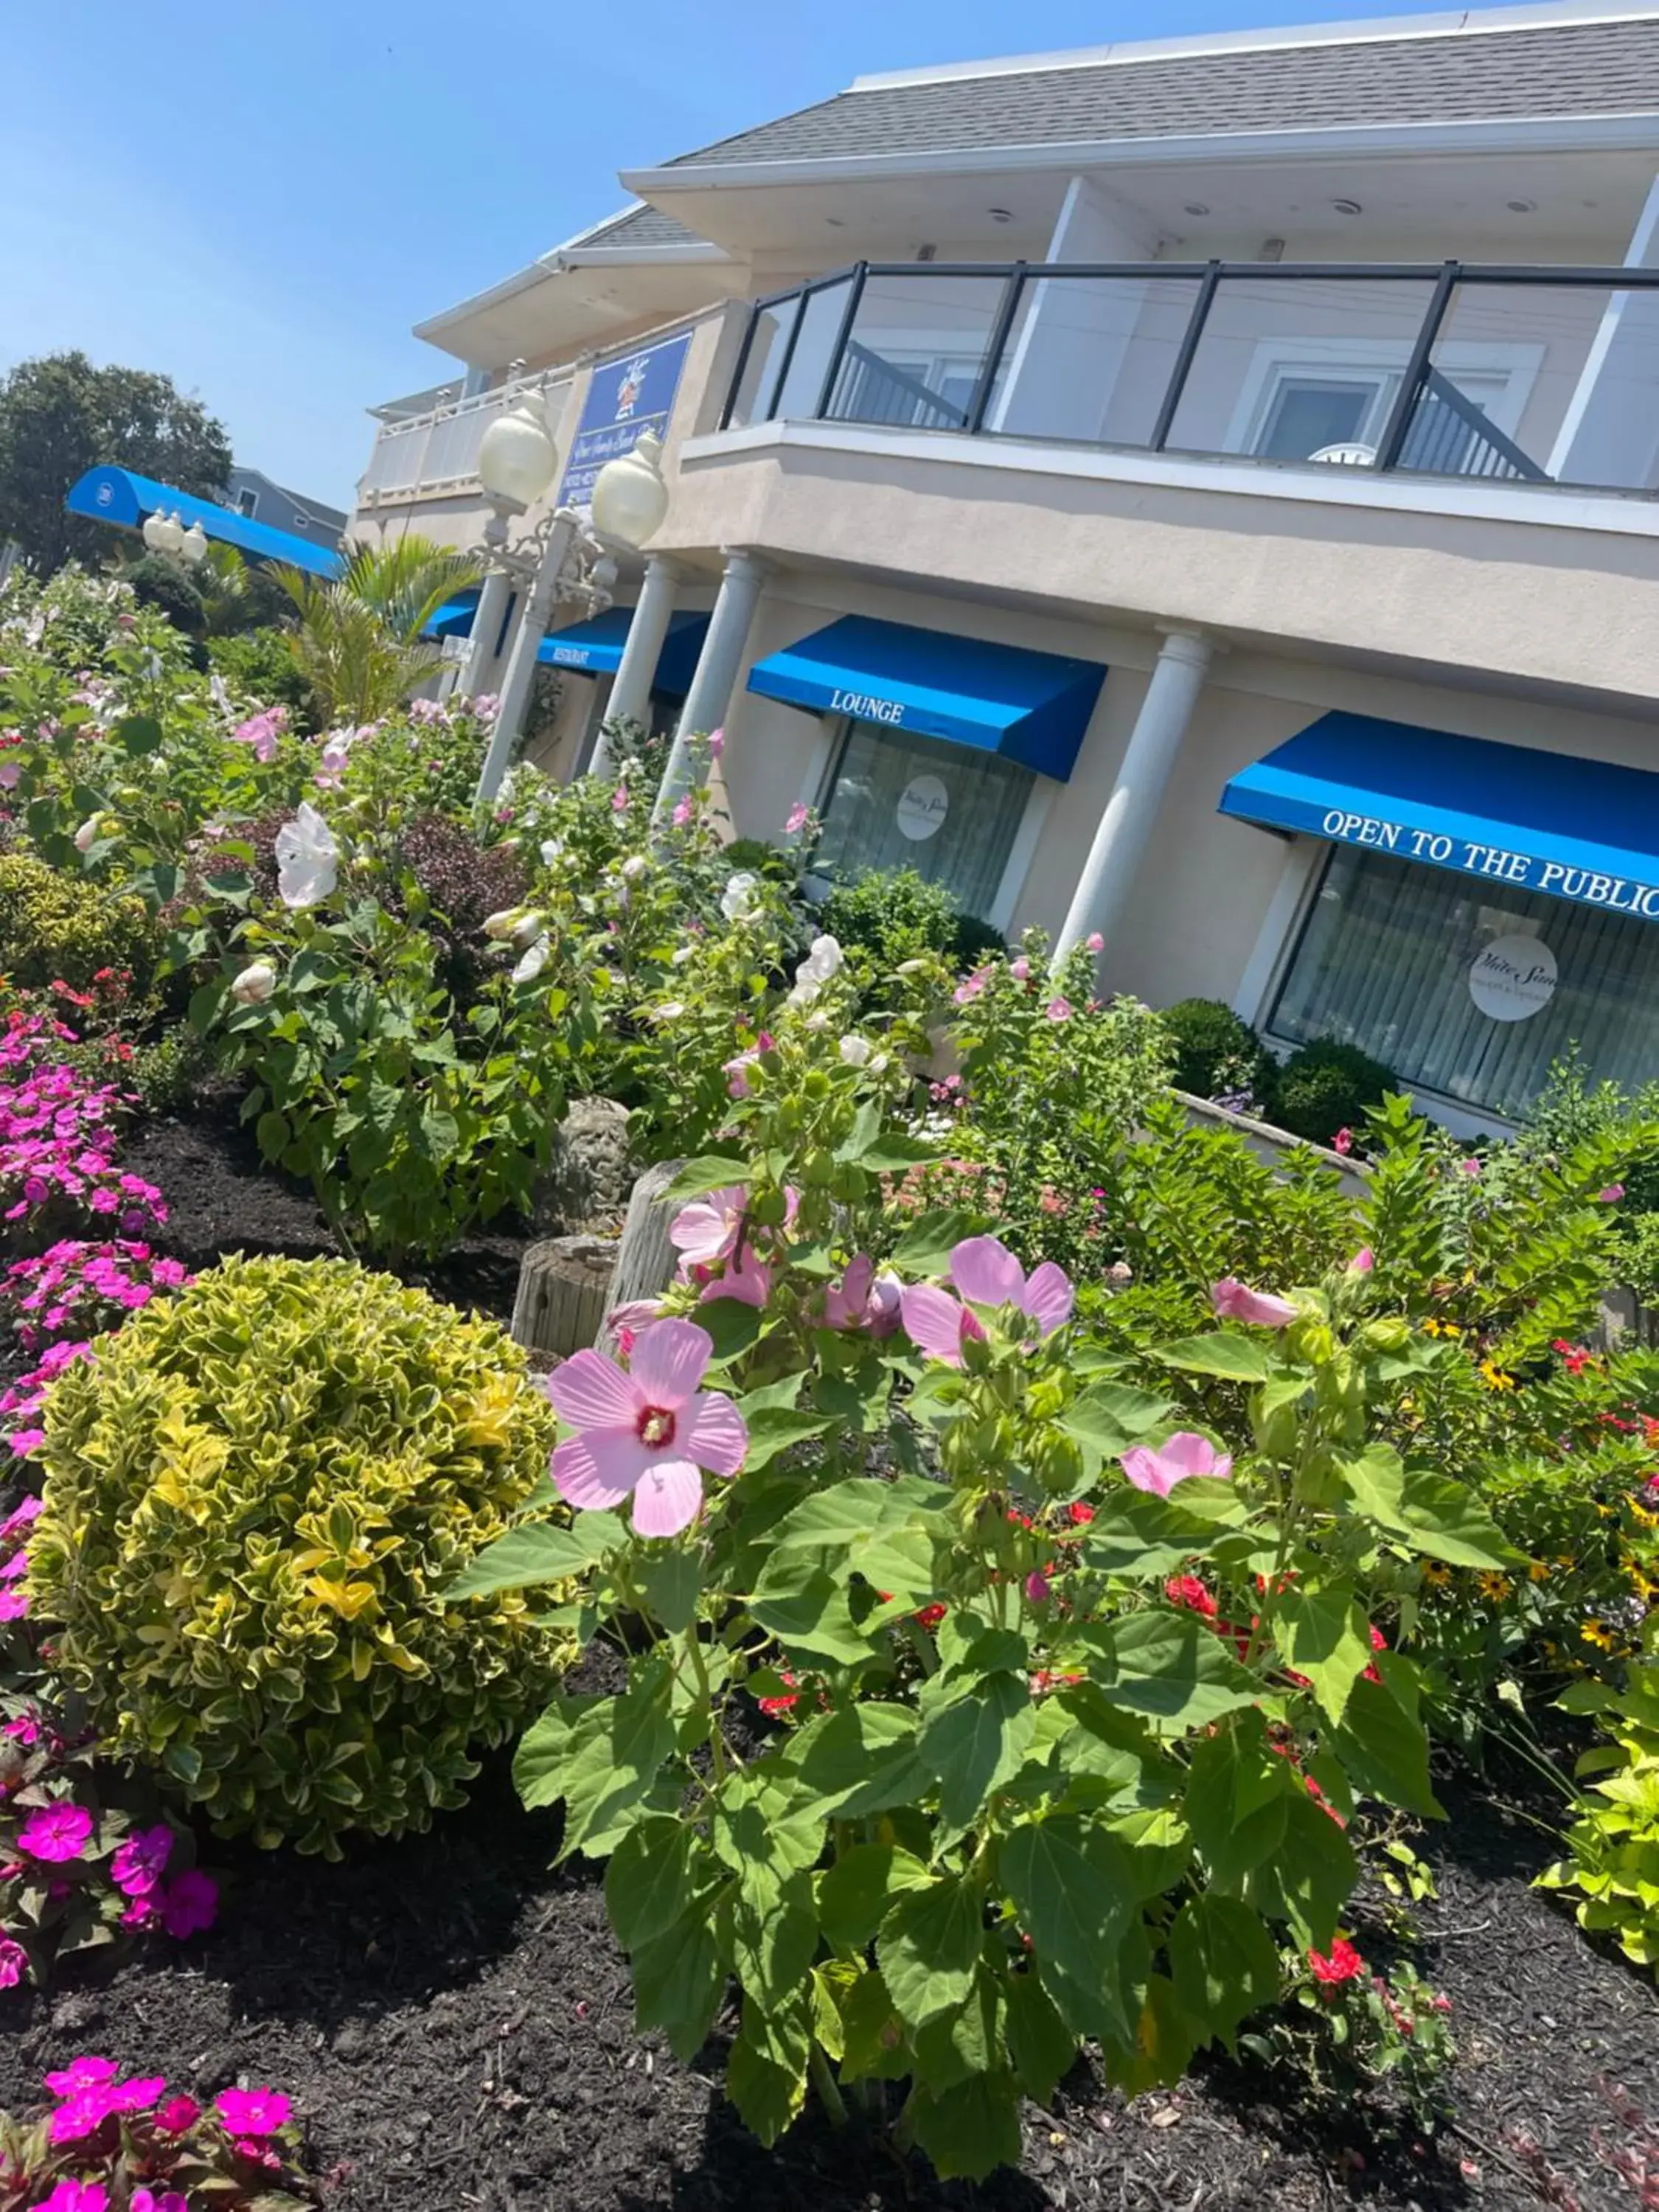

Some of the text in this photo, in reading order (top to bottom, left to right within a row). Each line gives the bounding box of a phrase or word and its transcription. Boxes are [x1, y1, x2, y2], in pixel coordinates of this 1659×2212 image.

[831, 689, 905, 724] LOUNGE
[1323, 810, 1659, 917] OPEN TO THE PUBLIC
